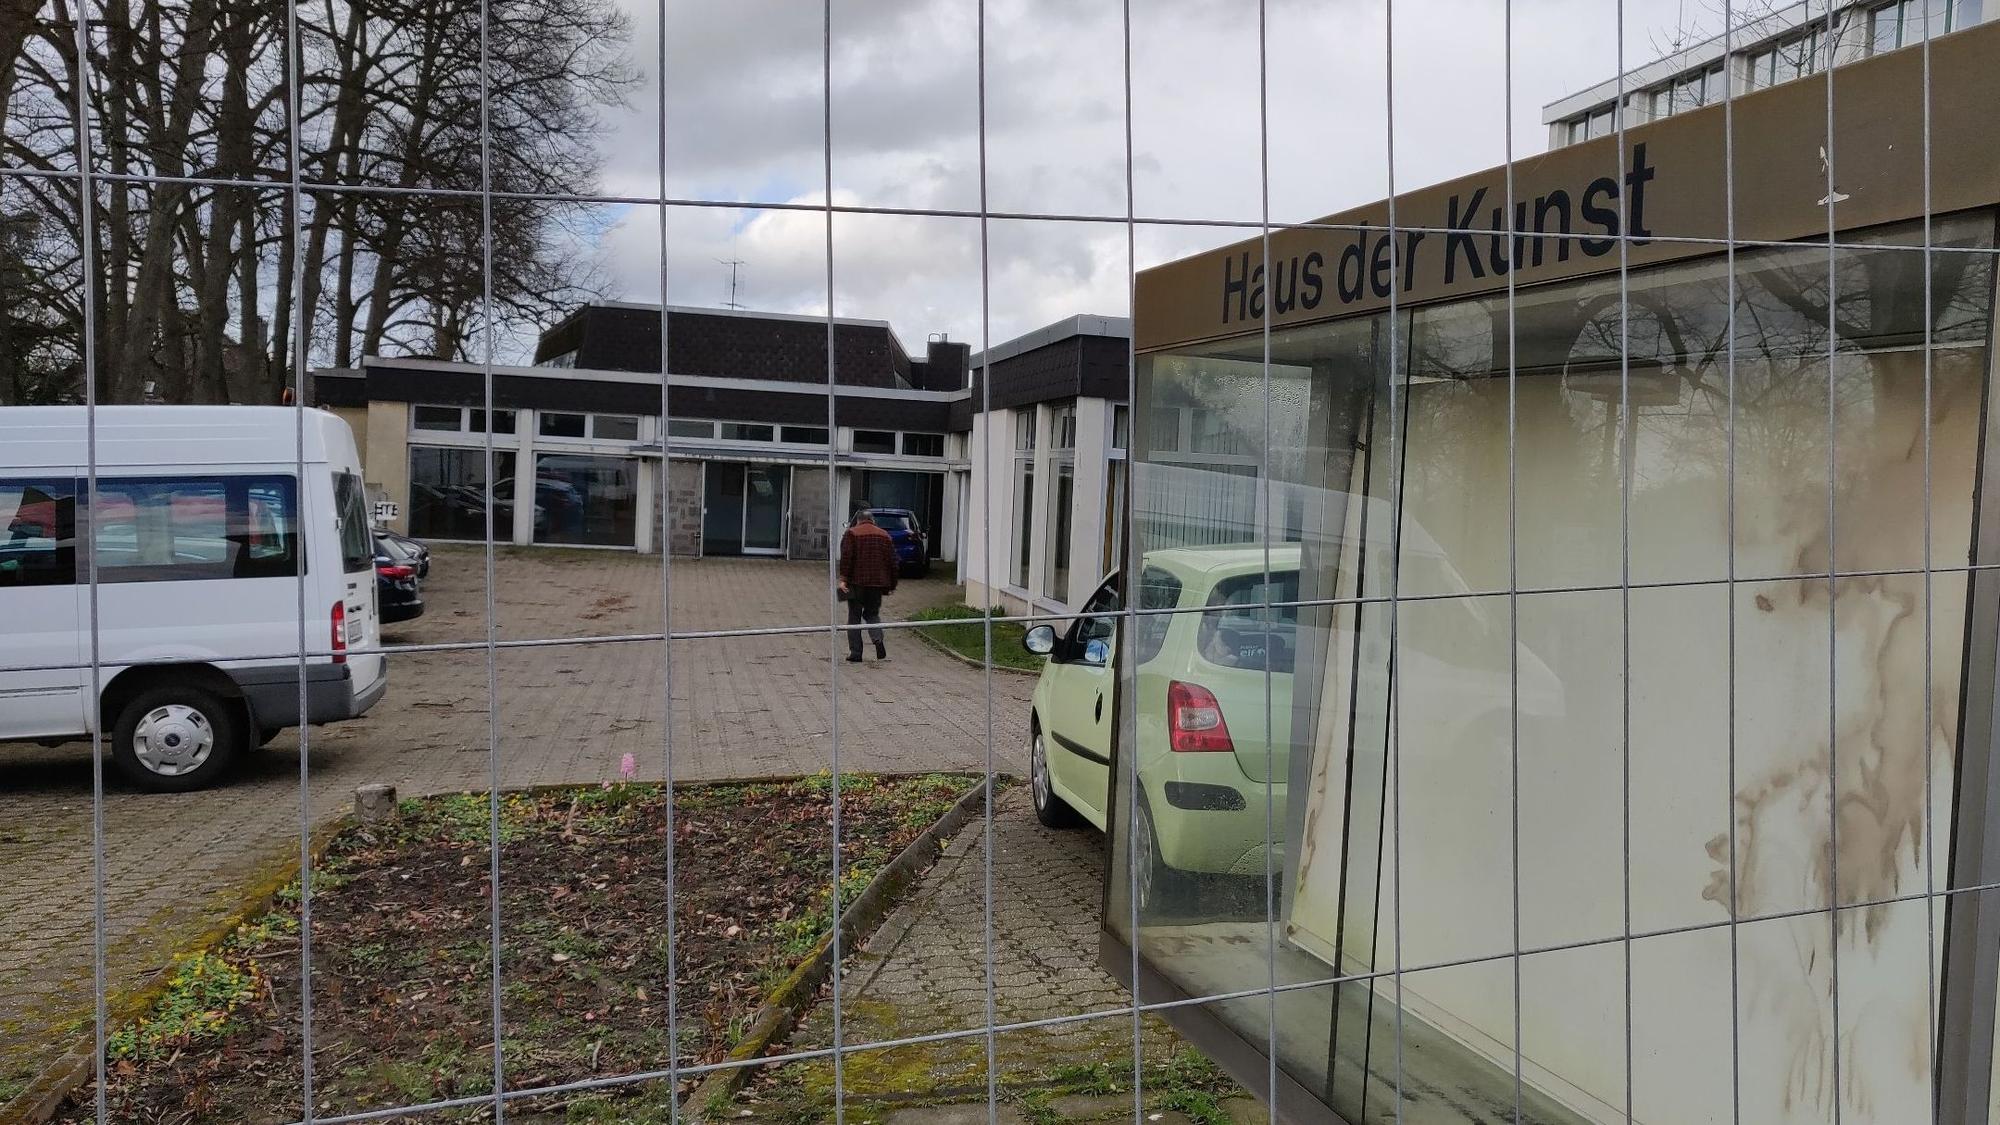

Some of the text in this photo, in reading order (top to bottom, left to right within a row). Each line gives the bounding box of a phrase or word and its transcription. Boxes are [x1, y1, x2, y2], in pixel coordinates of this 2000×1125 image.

[1222, 142, 1656, 324] Haus der Kunst
